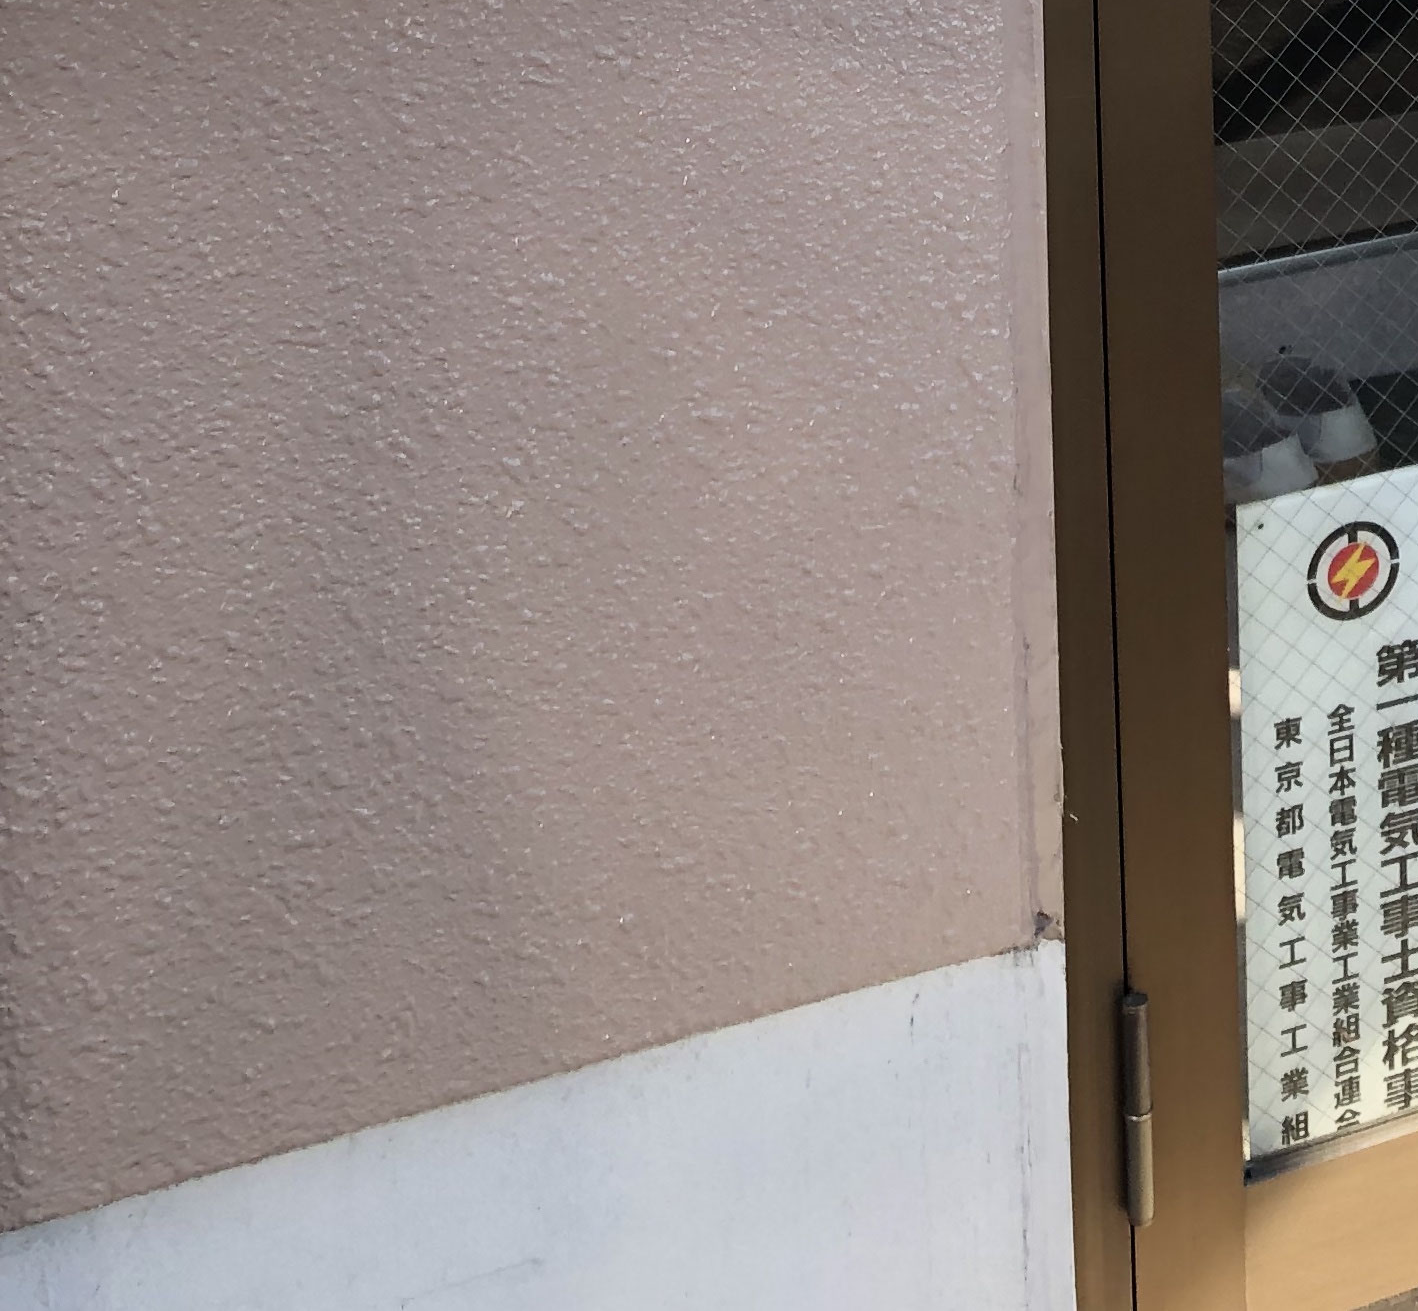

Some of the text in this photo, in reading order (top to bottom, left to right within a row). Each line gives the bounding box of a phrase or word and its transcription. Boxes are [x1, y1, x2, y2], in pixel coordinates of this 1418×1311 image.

[1274, 716, 1310, 1144] 東京都電気工事工業組
